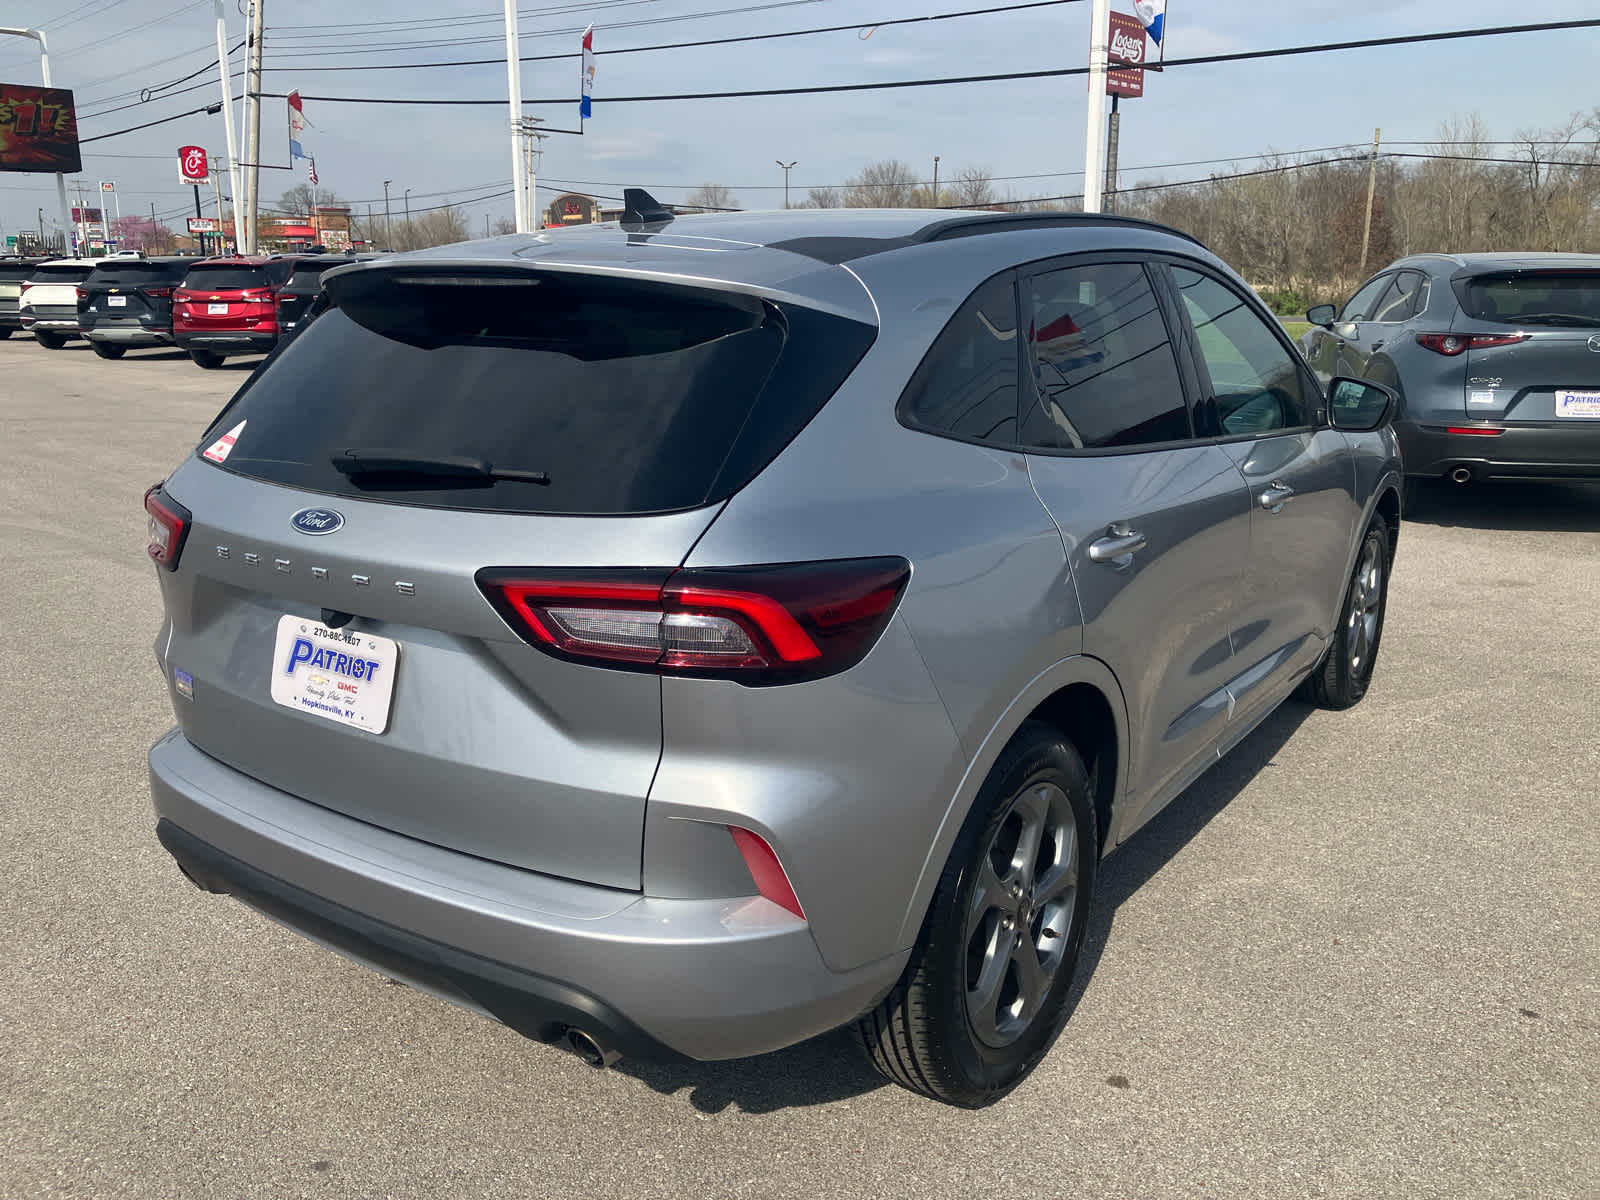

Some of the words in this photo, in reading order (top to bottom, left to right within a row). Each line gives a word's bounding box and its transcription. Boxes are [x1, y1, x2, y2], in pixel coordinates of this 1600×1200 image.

[1110, 28, 1143, 63] Logan's
[299, 510, 332, 529] Ford
[287, 639, 379, 682] PATRIOT
[337, 681, 358, 694] GMC
[301, 697, 344, 718] Hopkinsville,
[344, 709, 356, 719] KY
